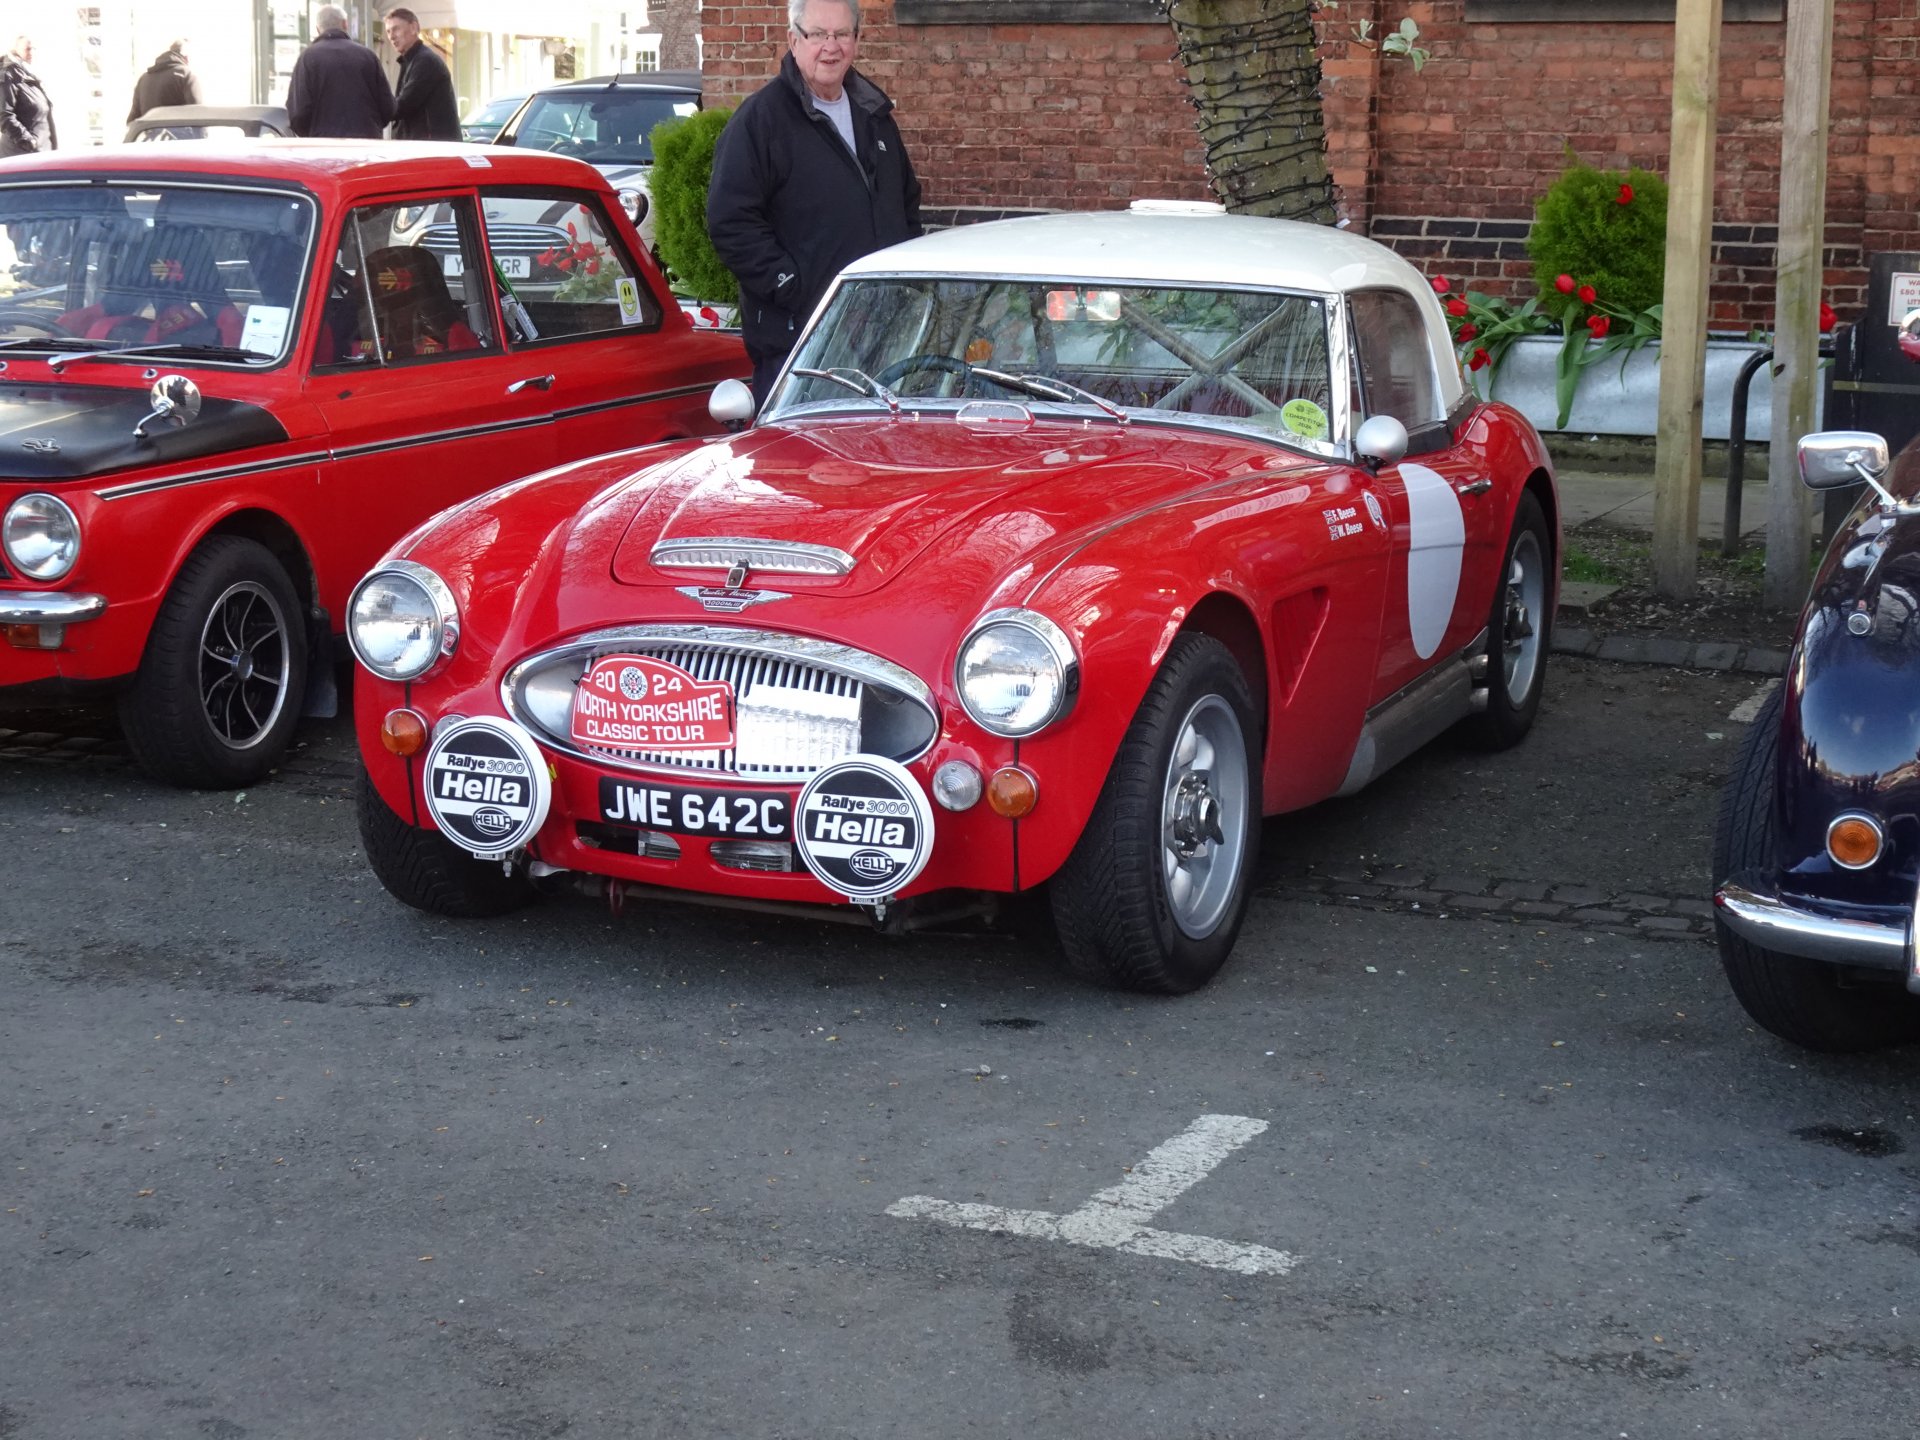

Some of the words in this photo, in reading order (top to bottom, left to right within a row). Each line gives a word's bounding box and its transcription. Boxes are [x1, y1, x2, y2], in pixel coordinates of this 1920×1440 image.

[700, 588, 726, 597] Austin
[728, 589, 757, 600] Healey
[595, 671, 616, 693] 20
[652, 674, 683, 696] 24
[577, 685, 618, 720] NORTH
[620, 692, 723, 722] YORKSHIRE
[586, 719, 649, 741] CLASSIC
[652, 725, 705, 741] TOUR
[447, 754, 486, 771] Rallye
[486, 759, 525, 774] 3000
[441, 771, 521, 804] Hella
[605, 785, 673, 827] JWE
[681, 793, 785, 835] 642C
[821, 795, 865, 812] Rallye
[866, 800, 910, 815] 3000
[475, 814, 512, 830] HELLA
[814, 813, 906, 846] Hella
[852, 857, 895, 873] HELLA
